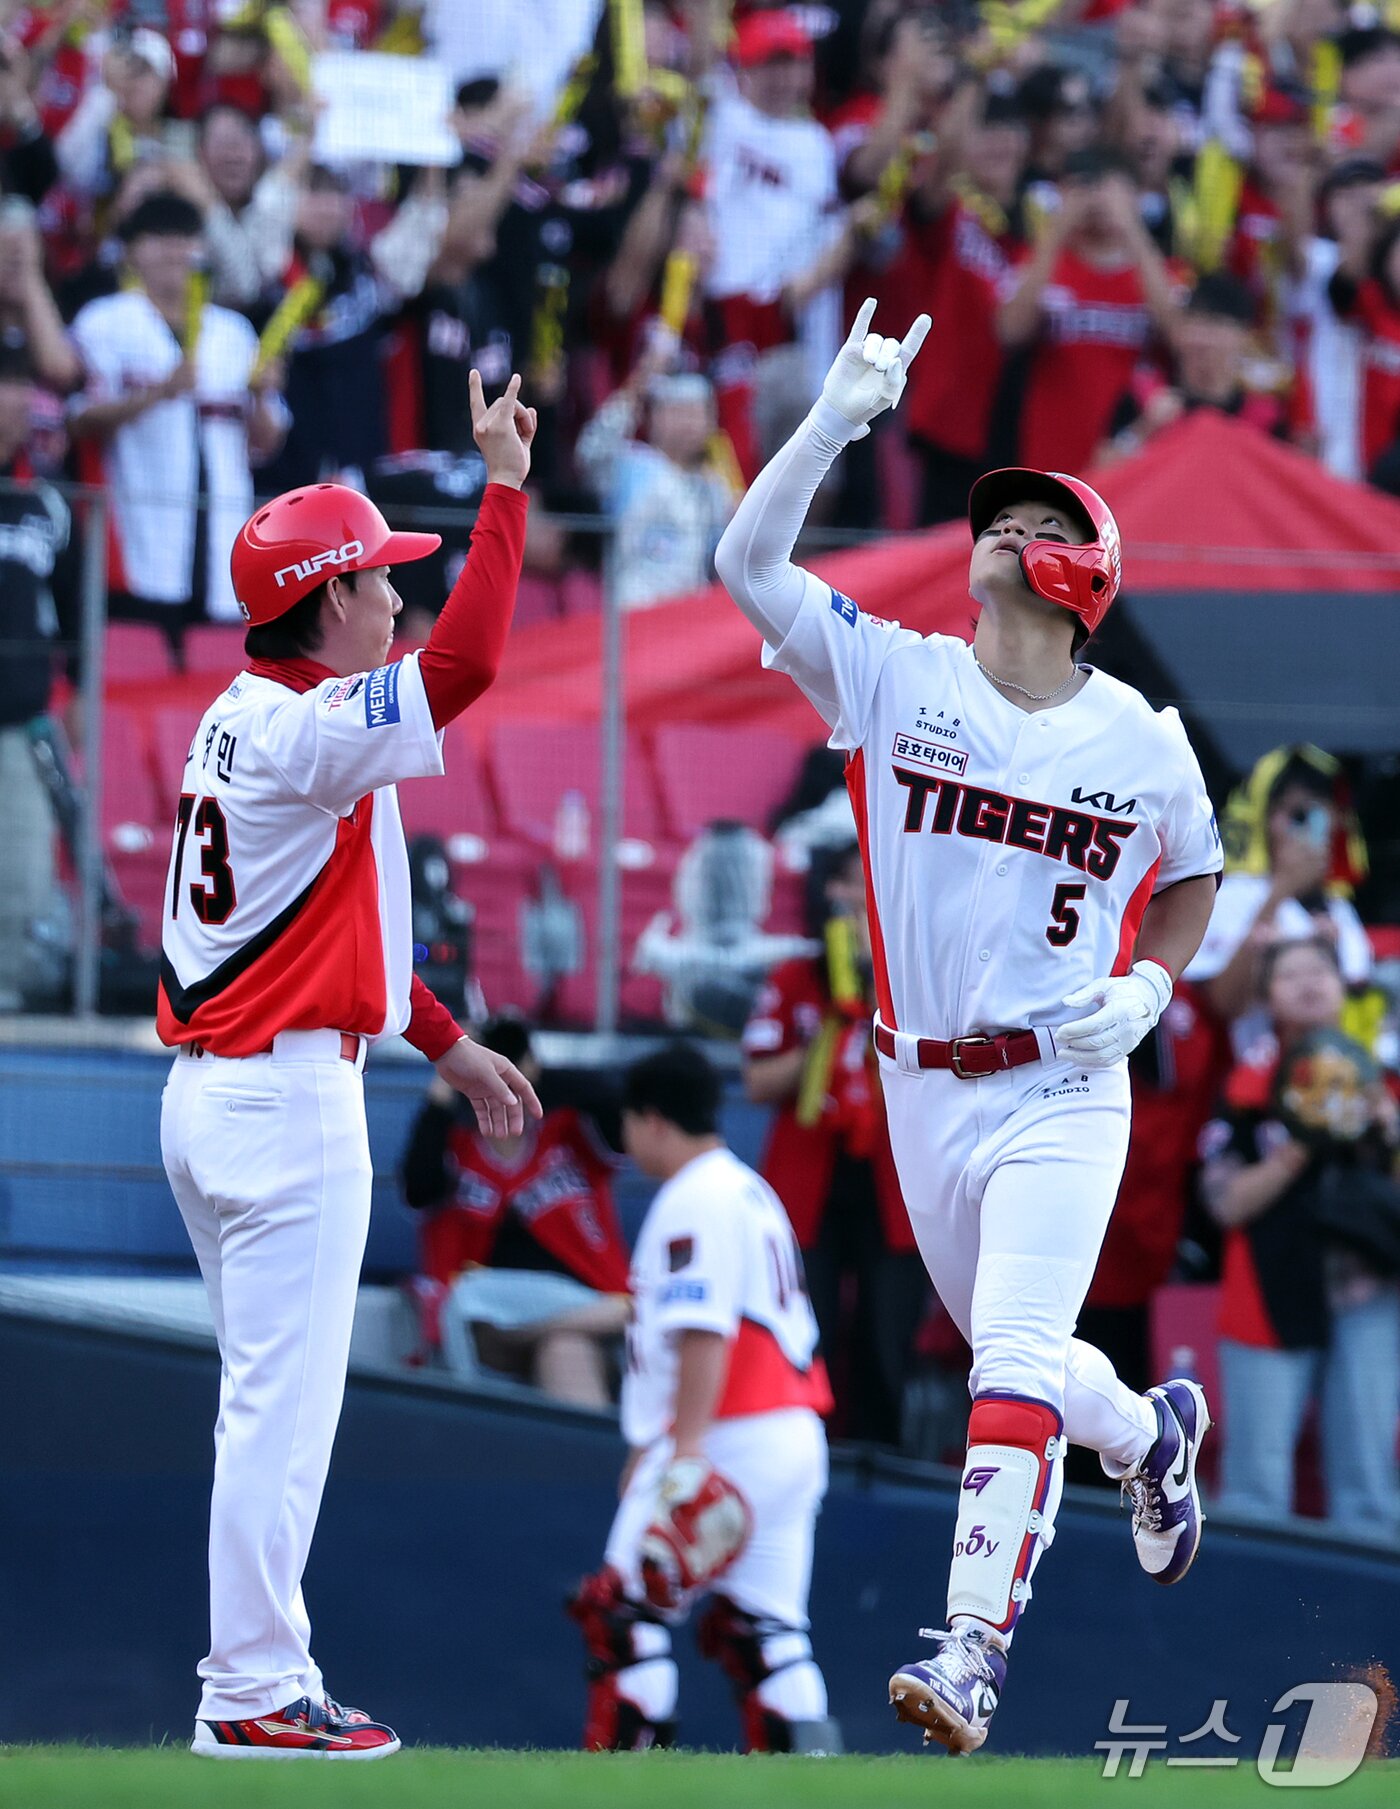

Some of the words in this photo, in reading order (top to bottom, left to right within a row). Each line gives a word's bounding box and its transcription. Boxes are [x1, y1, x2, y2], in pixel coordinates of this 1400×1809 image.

[274, 539, 364, 588] NIRO
[897, 738, 965, 772] 금호타이어
[915, 719, 957, 739] STUDIO
[892, 765, 1139, 882] TIGERS
[172, 792, 238, 925] 73
[1046, 883, 1087, 947] 5
